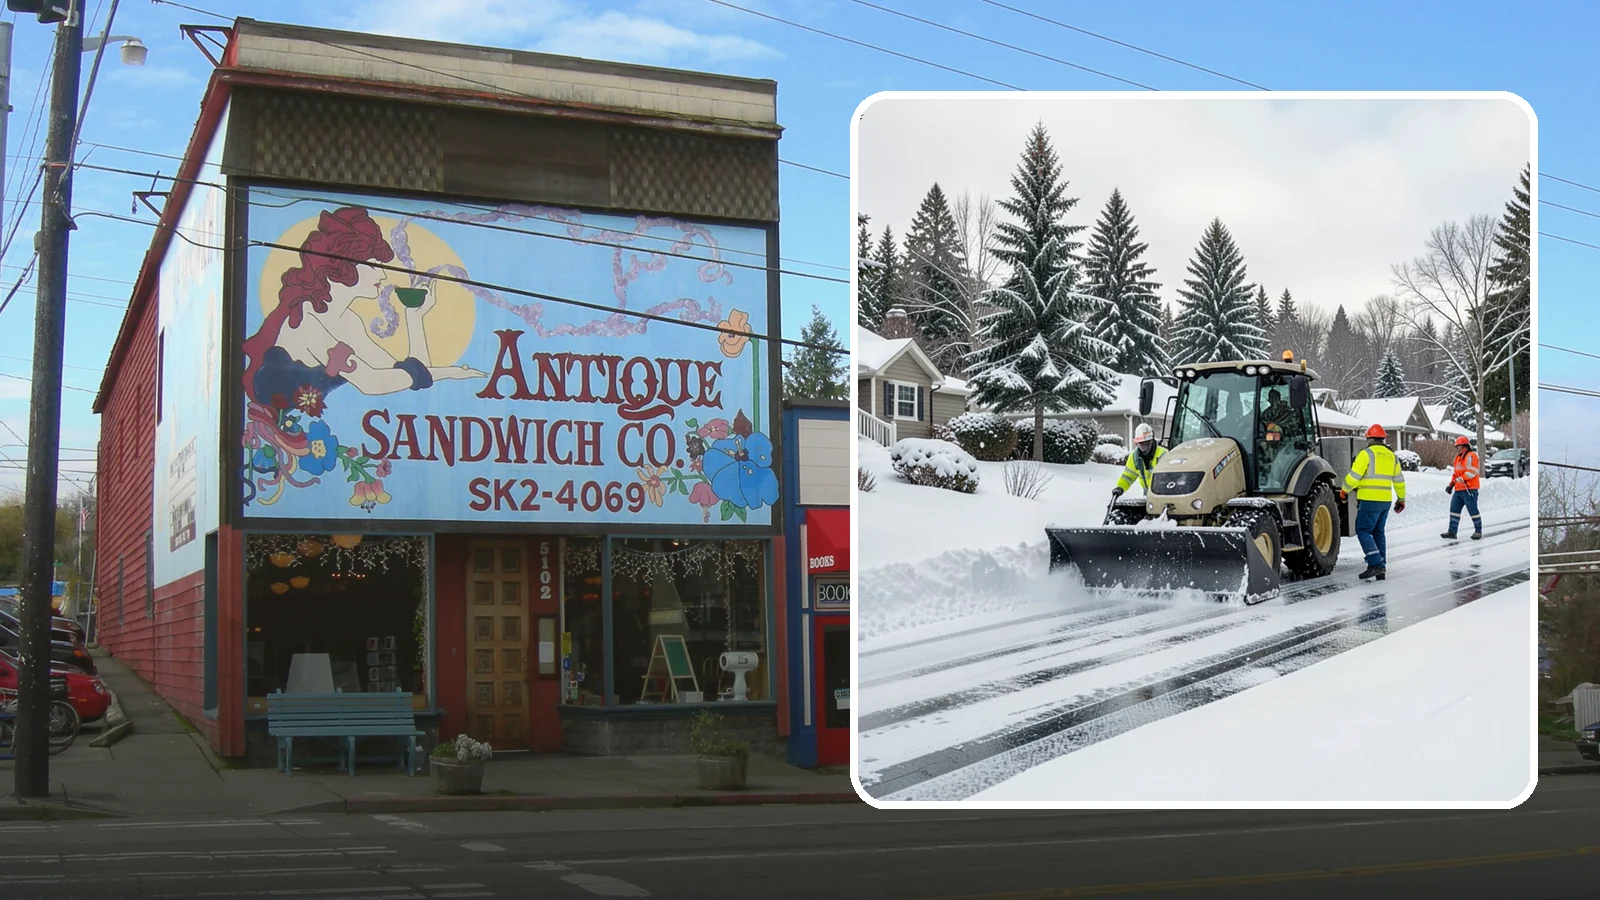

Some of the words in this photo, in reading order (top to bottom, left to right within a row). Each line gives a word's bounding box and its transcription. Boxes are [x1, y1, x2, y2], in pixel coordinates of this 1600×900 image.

[476, 329, 723, 420] ANTIQUE
[361, 408, 604, 467] SANDWICH
[617, 422, 685, 469] CO.
[468, 477, 645, 513] SK2-4069
[540, 543, 551, 599] 5102
[809, 555, 835, 568] BOOKS
